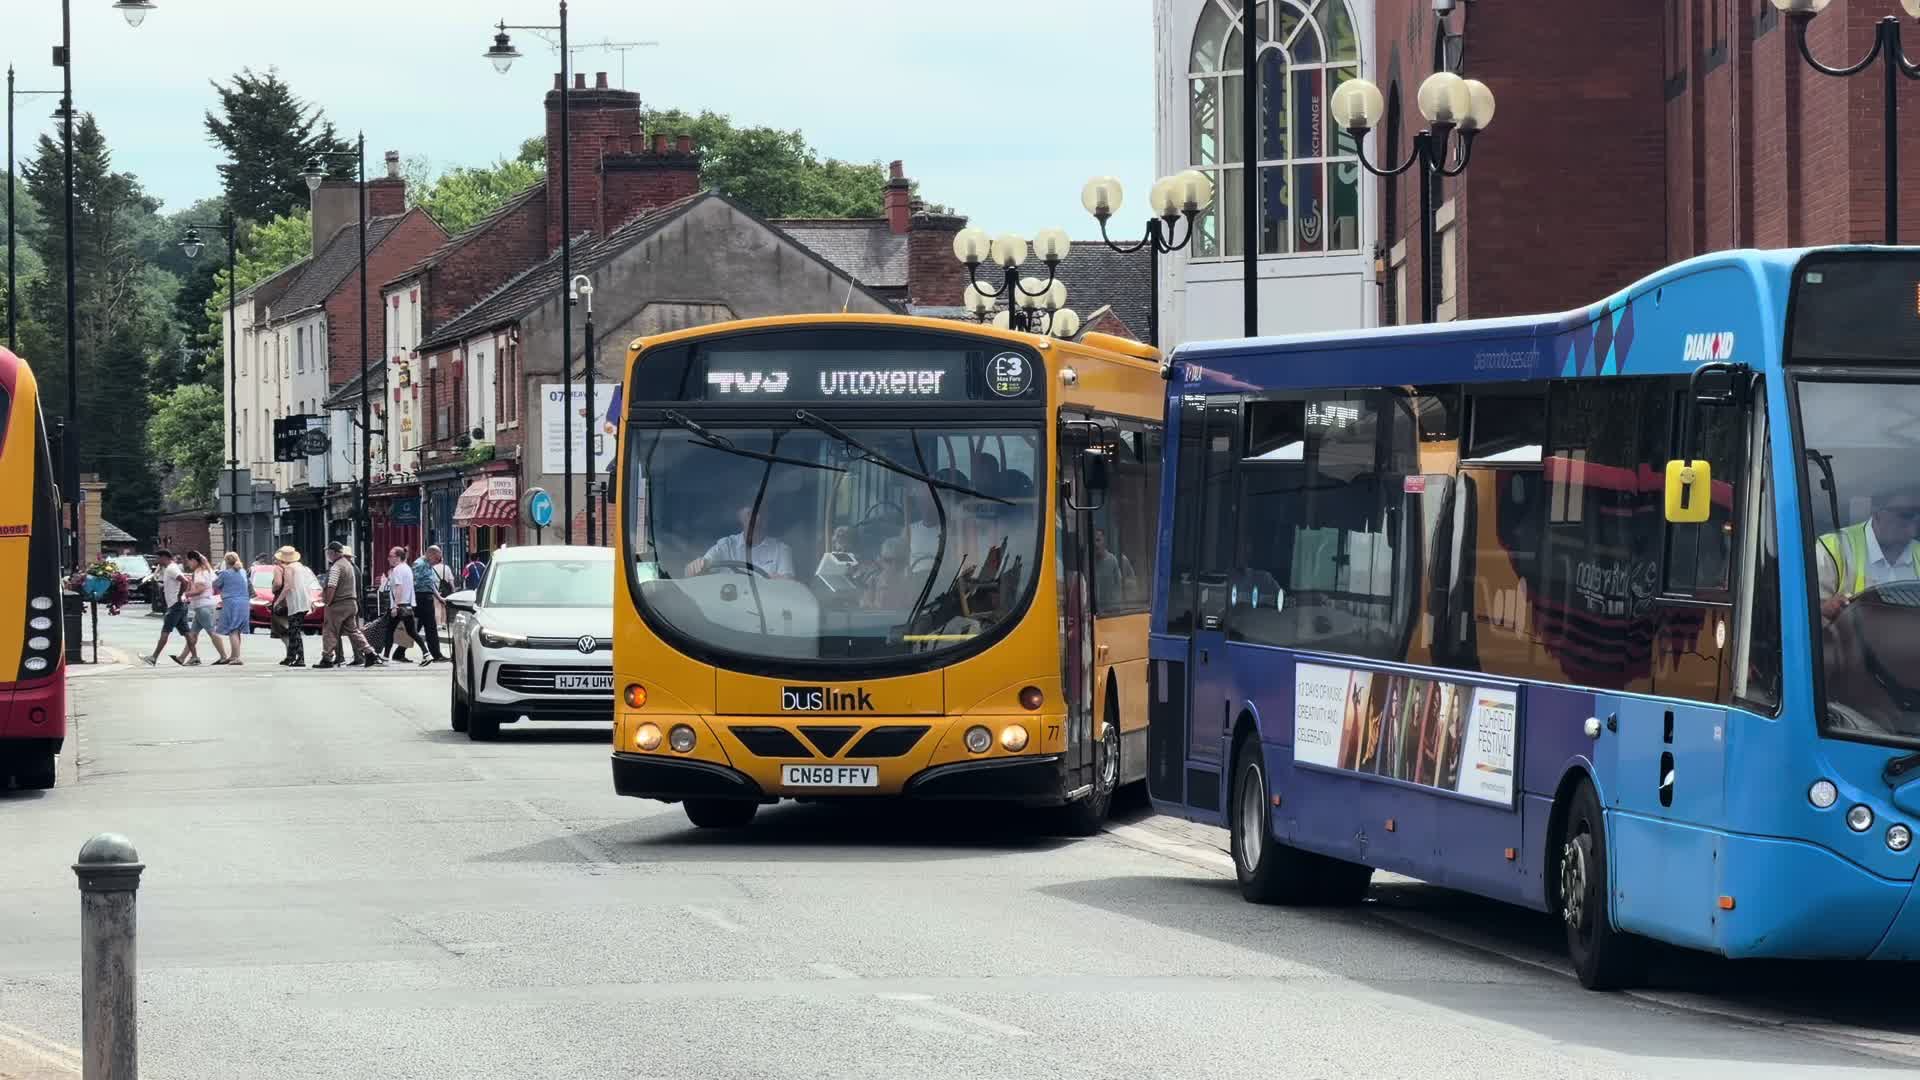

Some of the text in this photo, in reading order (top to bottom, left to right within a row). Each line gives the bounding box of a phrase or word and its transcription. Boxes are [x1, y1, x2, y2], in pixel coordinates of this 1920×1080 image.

[995, 357, 1022, 376] £3
[559, 676, 614, 688] HJ74 UHV
[1479, 707, 1512, 732] LICHFIELD
[1047, 725, 1060, 741] 77
[1297, 727, 1332, 746] CELEBRATION
[1479, 730, 1512, 757] FESTIVAL
[789, 767, 870, 784] CN58 FFV
